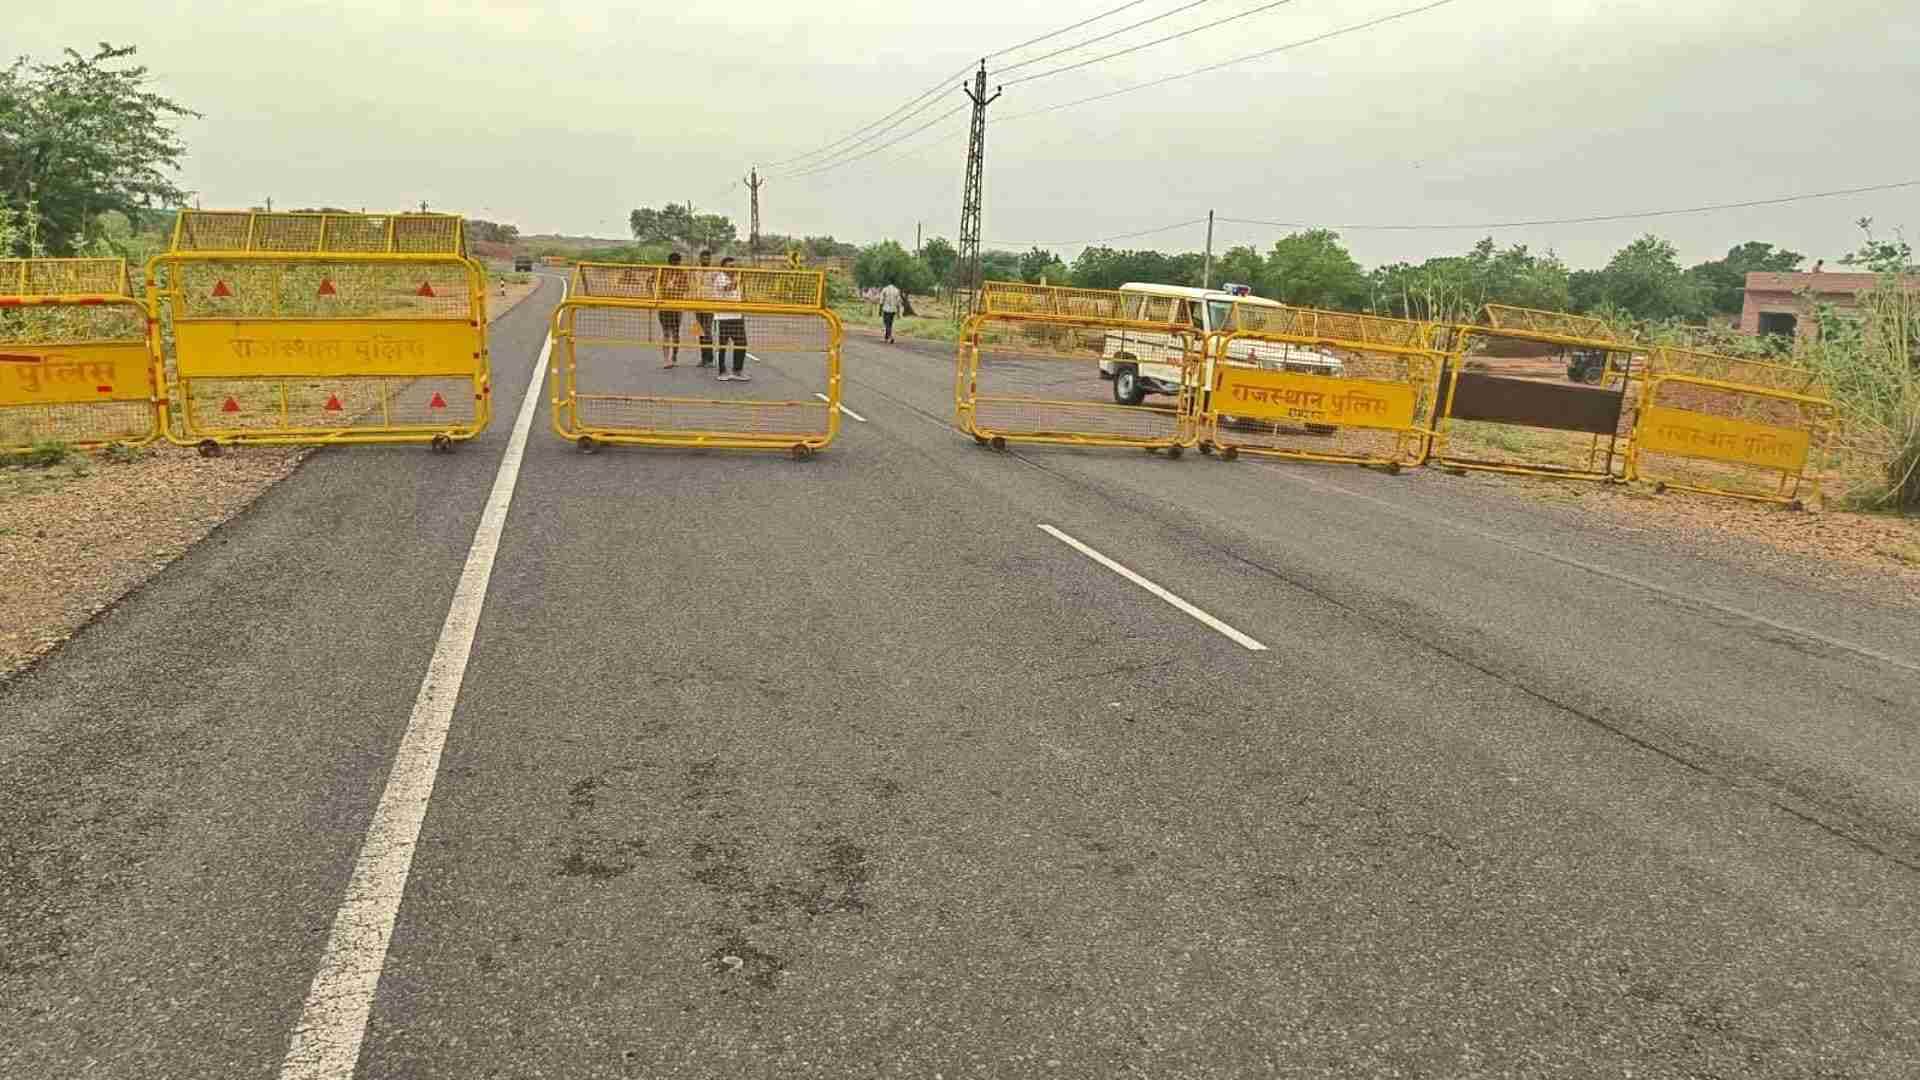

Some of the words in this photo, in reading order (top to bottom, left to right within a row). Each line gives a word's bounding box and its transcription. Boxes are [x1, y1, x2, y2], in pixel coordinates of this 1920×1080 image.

[16, 353, 116, 393] पुलिस
[1231, 383, 1326, 410] राजस्थान
[1330, 389, 1389, 417] पुलिस
